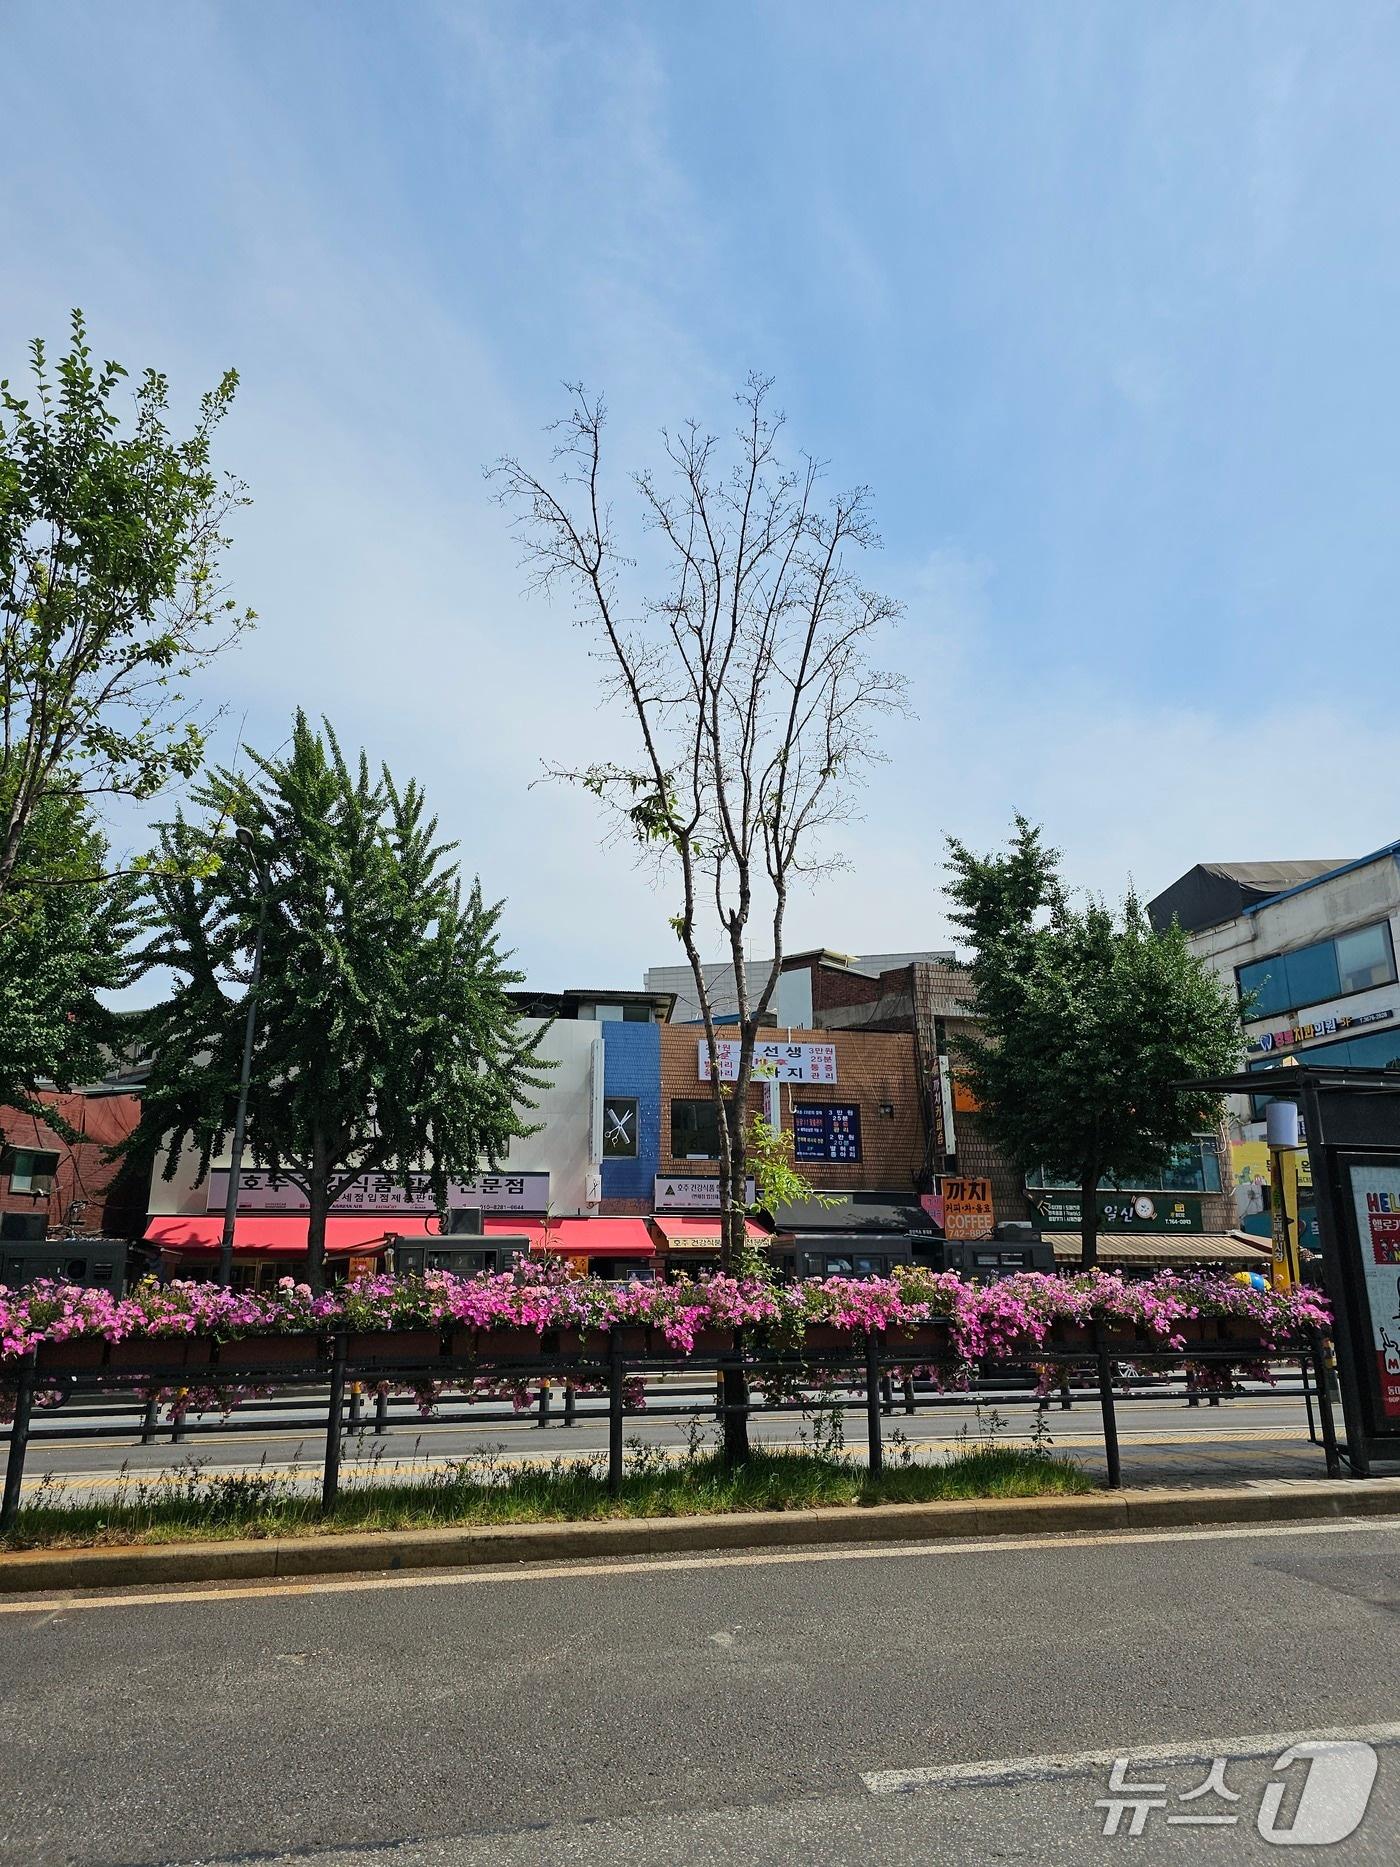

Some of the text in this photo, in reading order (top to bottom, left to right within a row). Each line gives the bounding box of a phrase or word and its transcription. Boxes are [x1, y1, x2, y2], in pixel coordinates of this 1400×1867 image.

[809, 1047, 833, 1055] 3만원
[238, 1174, 290, 1193] 호주
[946, 1182, 987, 1201] 까치
[1366, 1192, 1400, 1213] HEL
[946, 1215, 992, 1229] COFFEE
